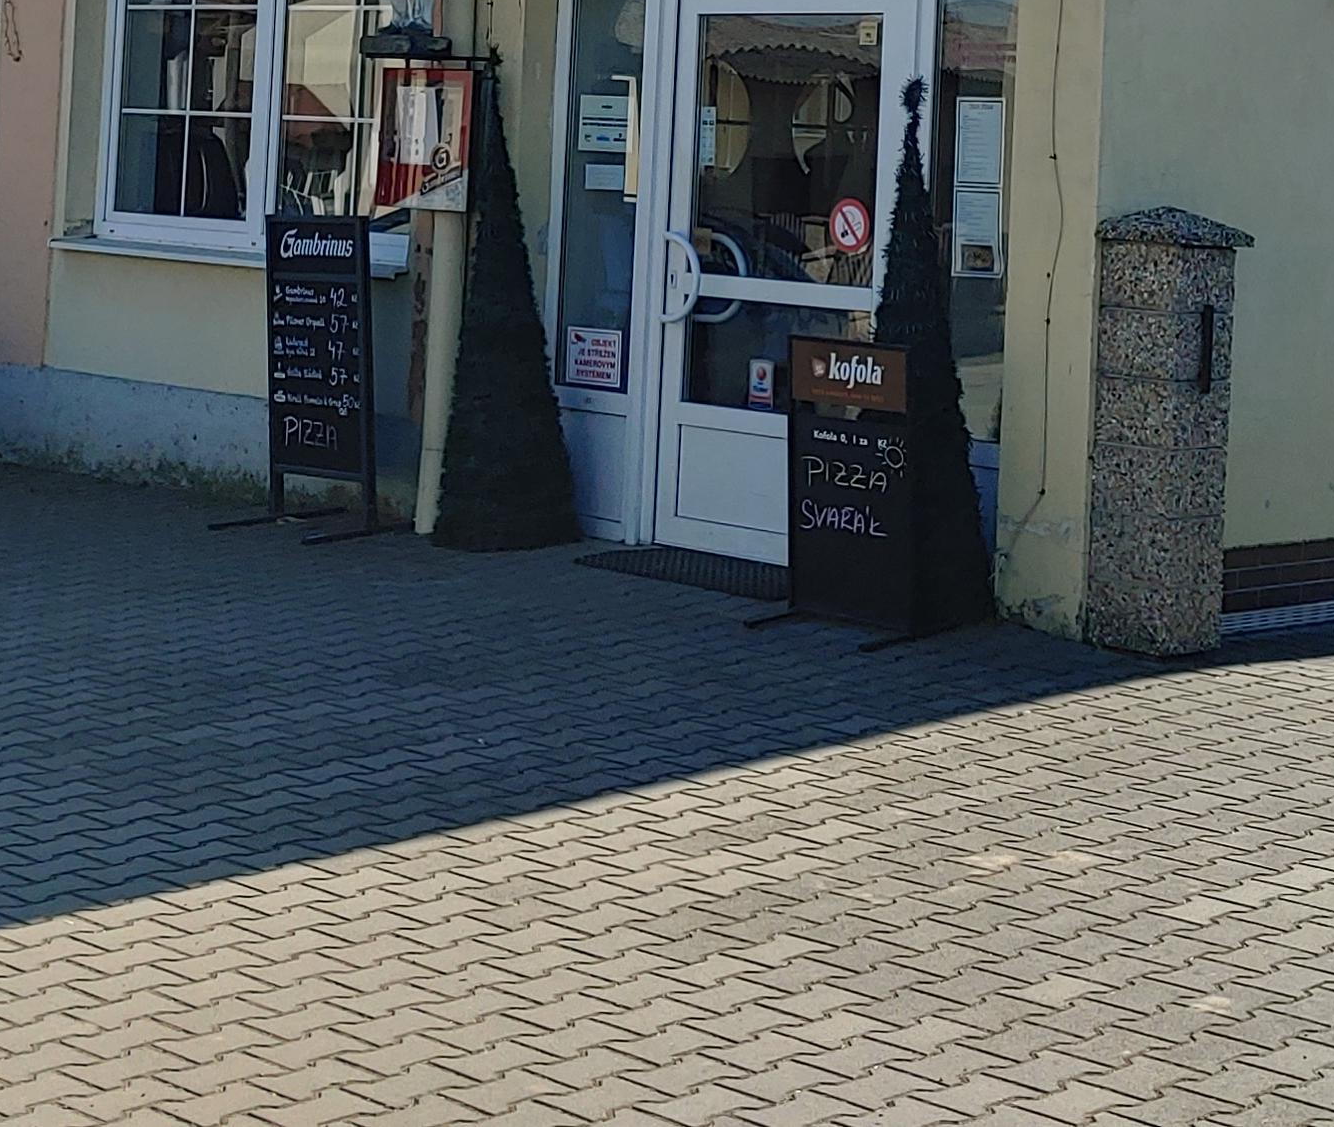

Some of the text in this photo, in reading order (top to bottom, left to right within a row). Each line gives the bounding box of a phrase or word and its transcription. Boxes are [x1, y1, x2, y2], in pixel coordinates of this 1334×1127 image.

[280, 228, 353, 259] Gambrinus
[330, 287, 348, 308] 42
[828, 352, 882, 389] kofola
[283, 416, 337, 450] PIZZA
[813, 429, 838, 442] Kofola
[800, 455, 887, 493] PIZZA
